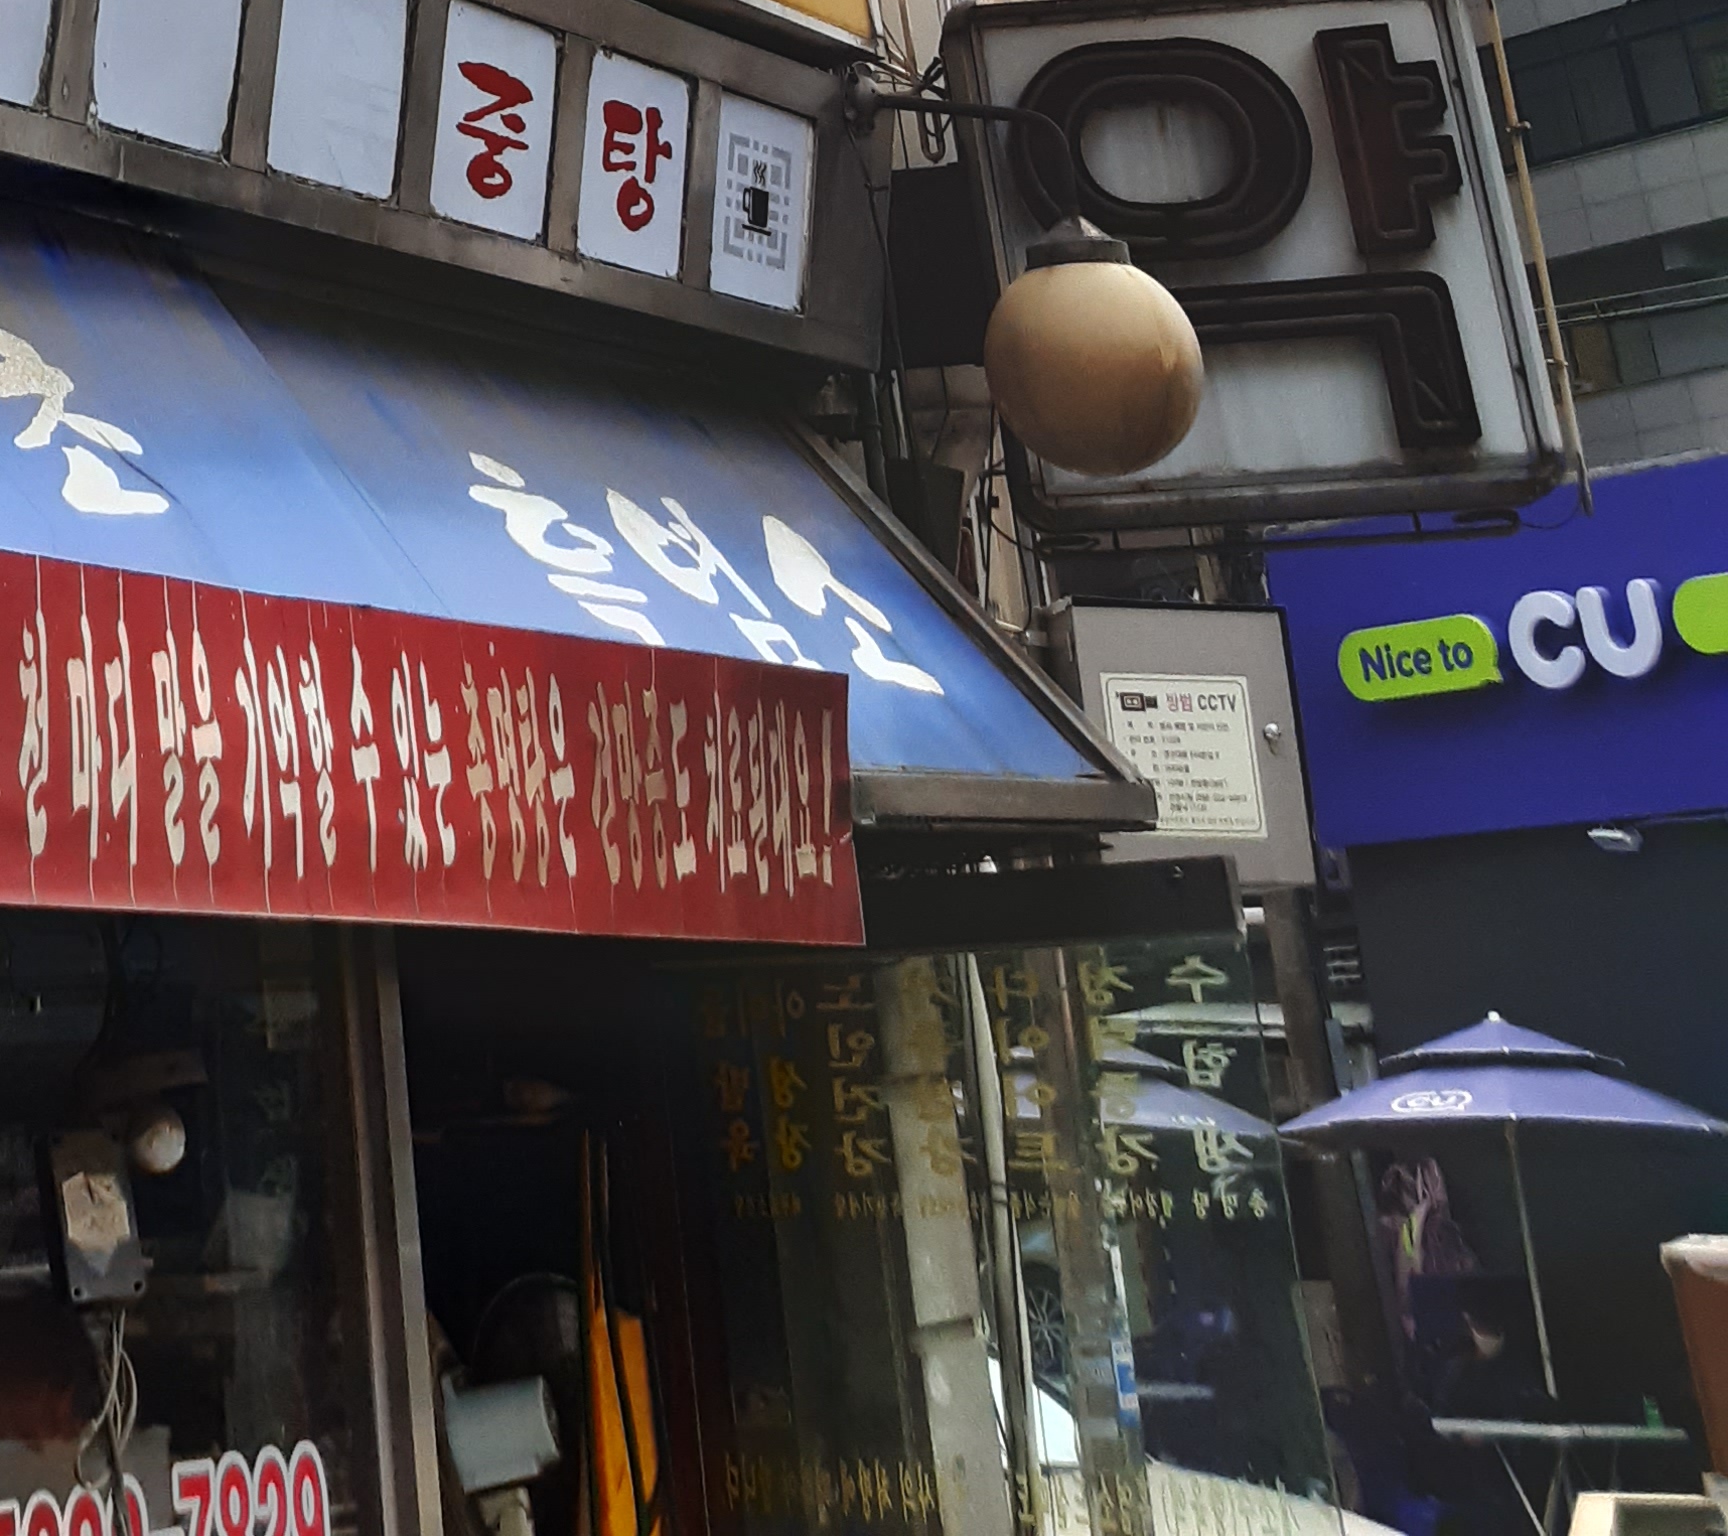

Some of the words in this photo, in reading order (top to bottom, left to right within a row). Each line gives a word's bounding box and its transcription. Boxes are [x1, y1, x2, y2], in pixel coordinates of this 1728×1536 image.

[1010, 23, 1482, 446] 약
[1358, 642, 1433, 684] Nice
[1437, 637, 1474, 672] to
[1508, 577, 1665, 690] CU
[1196, 693, 1237, 713] CCTV
[234, 634, 337, 880] 기억할
[350, 642, 381, 874] 수
[460, 660, 578, 890] 총명탕은
